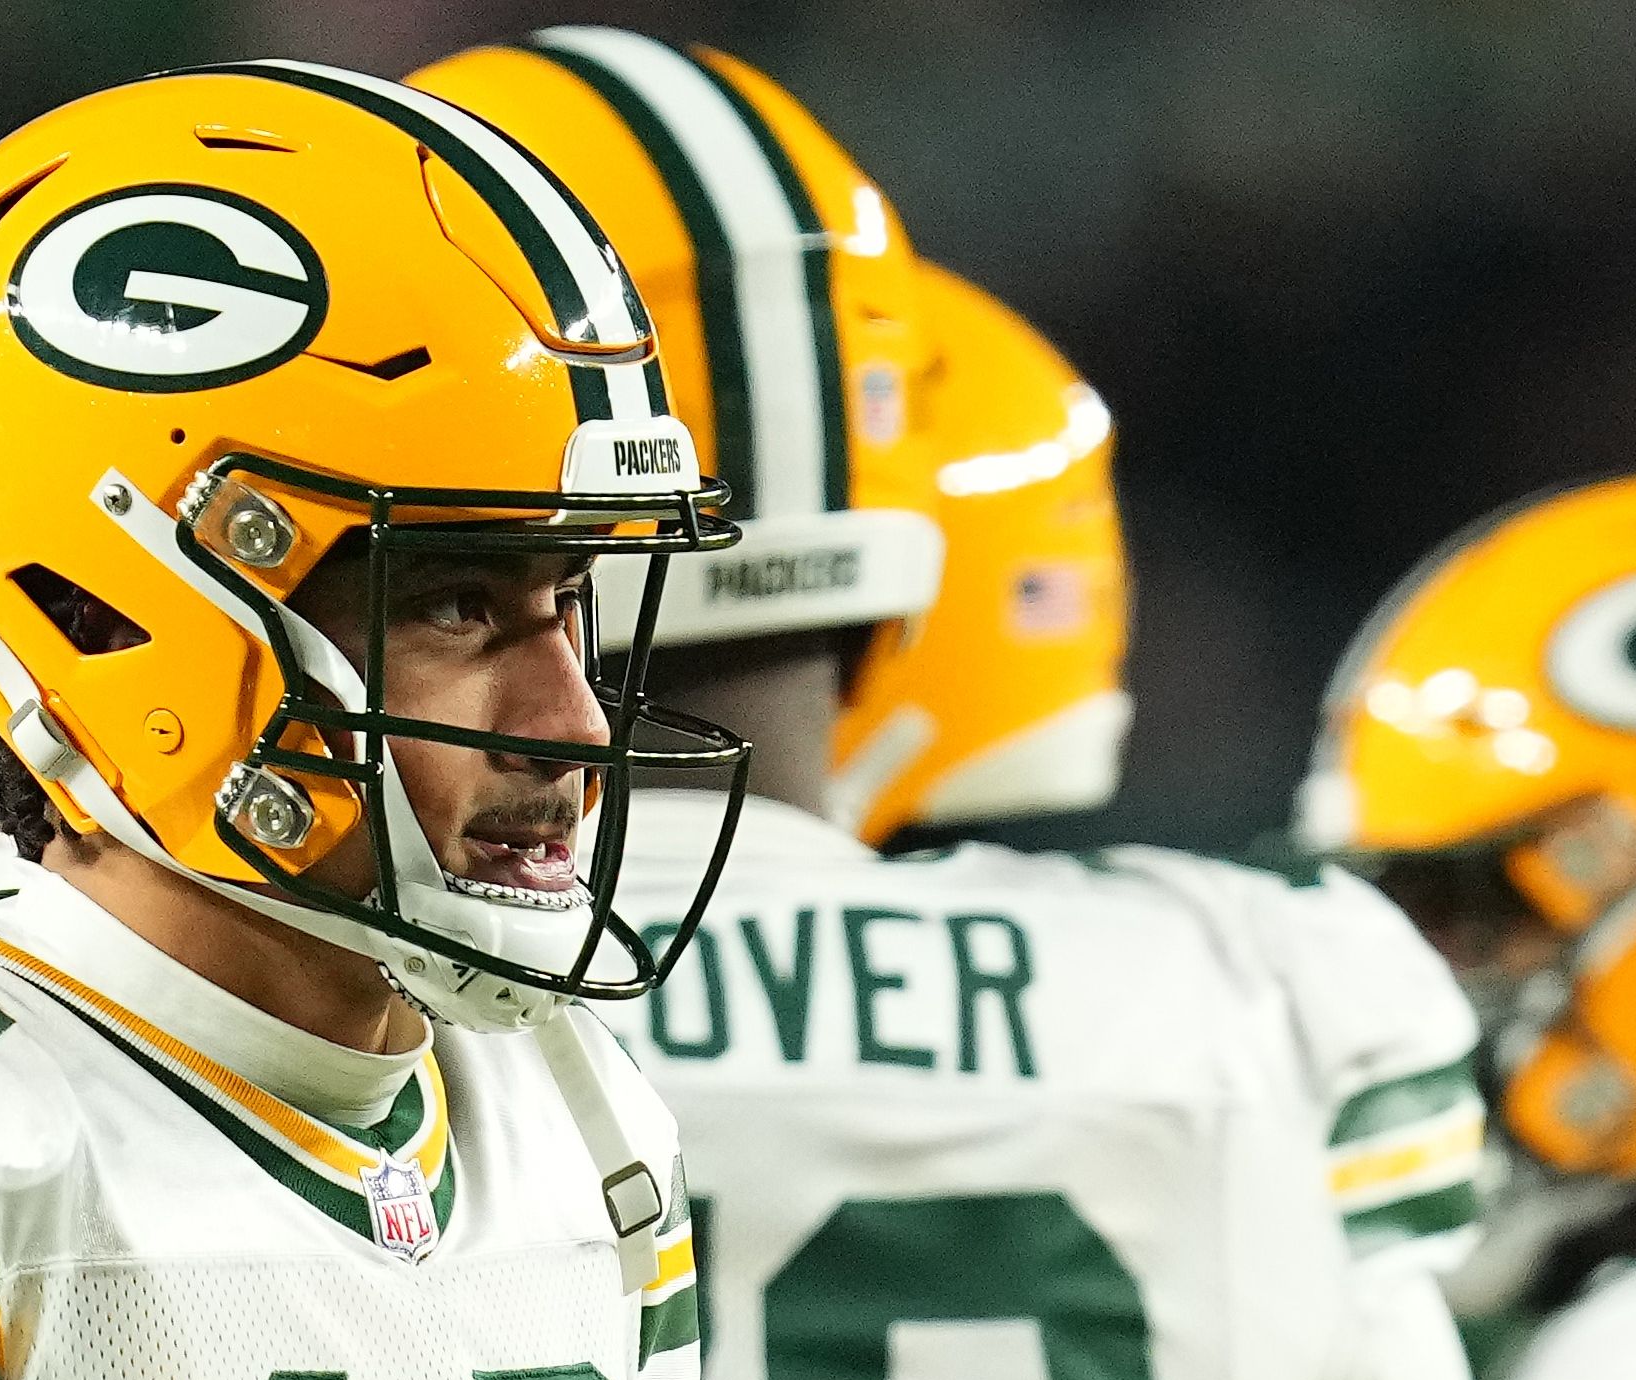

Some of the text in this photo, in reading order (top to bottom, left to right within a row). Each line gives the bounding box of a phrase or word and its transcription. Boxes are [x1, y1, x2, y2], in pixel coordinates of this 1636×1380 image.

[20, 194, 310, 376] G
[613, 438, 681, 476] PACKERS
[619, 907, 1039, 1079] OVER
[381, 1200, 430, 1244] NFL
